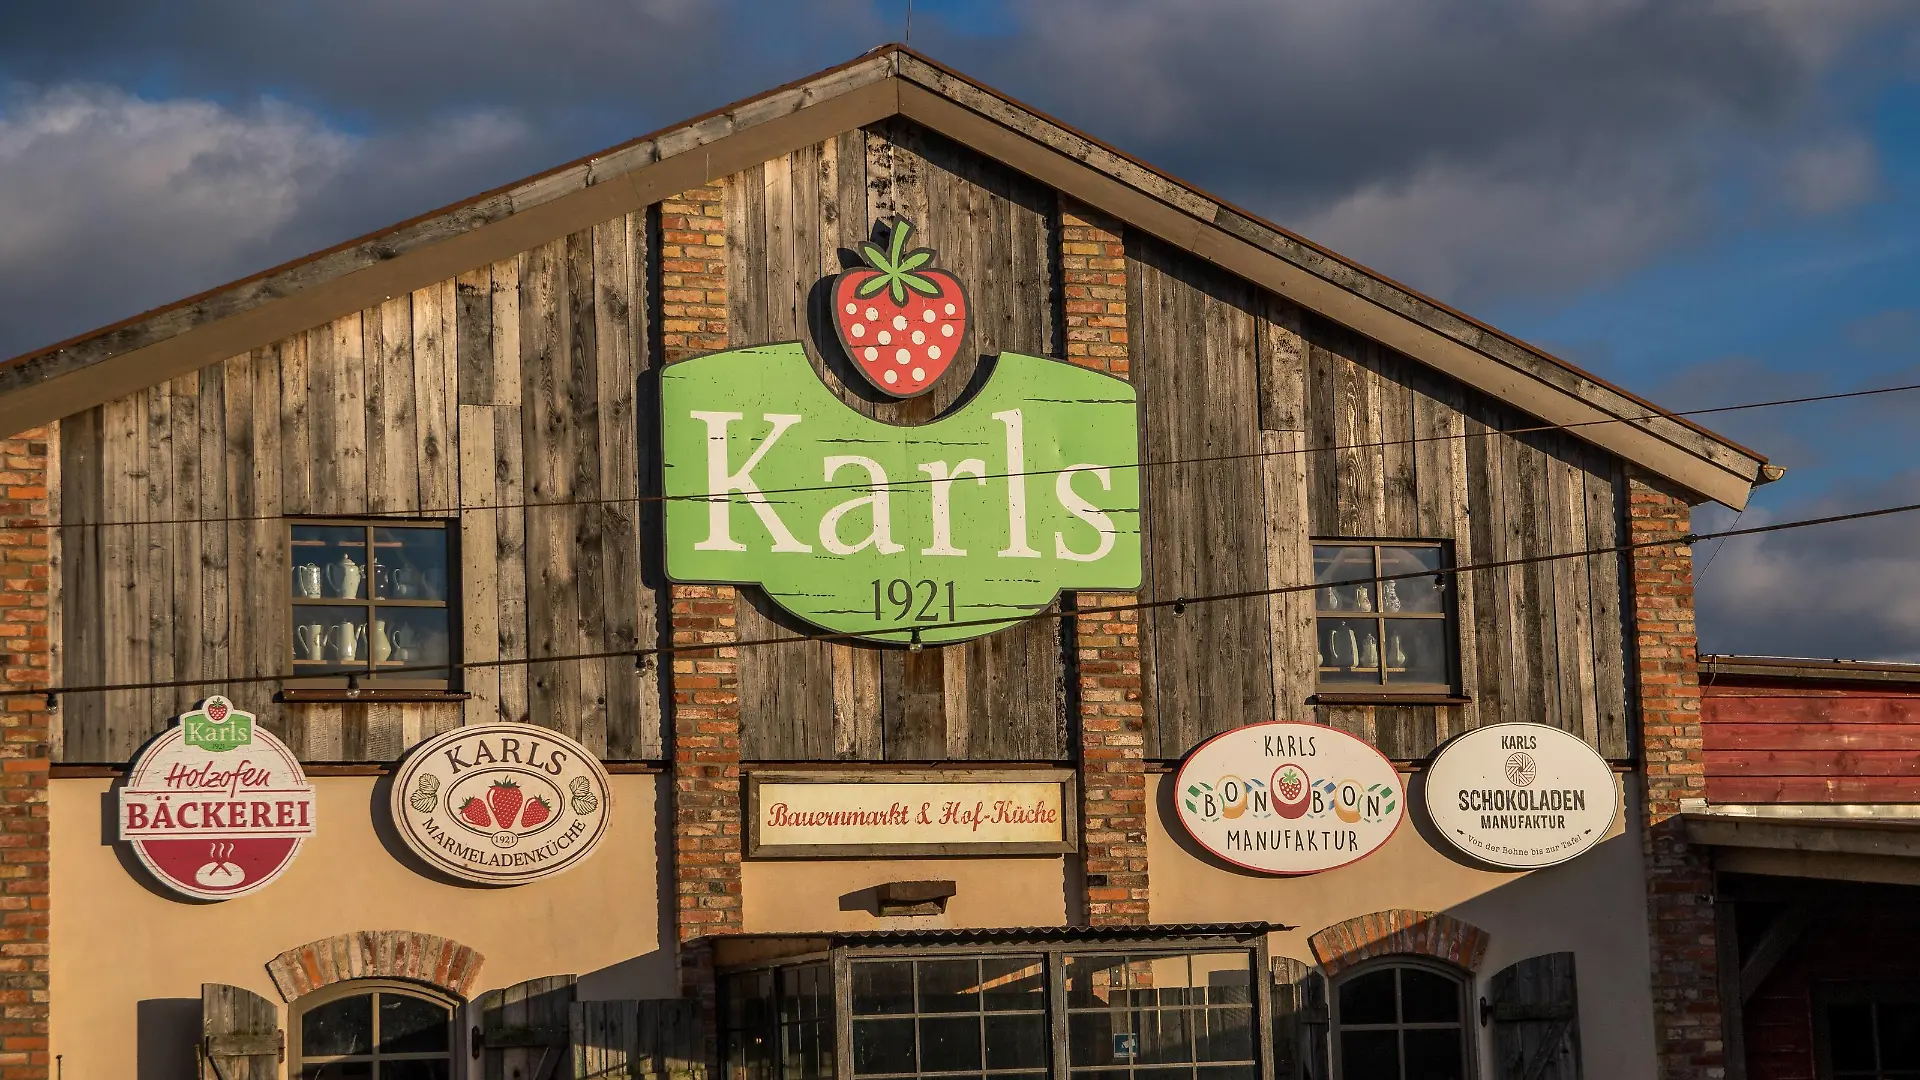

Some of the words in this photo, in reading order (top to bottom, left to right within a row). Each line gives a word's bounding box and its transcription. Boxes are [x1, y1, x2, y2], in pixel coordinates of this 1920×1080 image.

[690, 408, 1116, 562] Karls
[871, 578, 956, 622] 1921
[188, 721, 248, 742] Karls
[1501, 735, 1537, 750] KARLS
[444, 738, 567, 775] KARLS
[1264, 735, 1317, 757] KARLS
[164, 760, 271, 798] Holzofen
[1458, 789, 1585, 811] SCHOKOLADEN
[126, 795, 310, 829] BÄCKEREI
[767, 802, 909, 827] Bauernmarkt
[914, 802, 932, 825] &
[938, 800, 1057, 832] Hof-Küche
[1480, 815, 1565, 829] MANUFAKTUR
[421, 817, 586, 867] MARMELADENKÜCHE
[494, 834, 515, 844] 1921
[1227, 829, 1358, 851] MANUFAKTUR
[1468, 834, 1484, 848] Von
[1485, 841, 1500, 853] der
[1502, 846, 1529, 856] Bohne
[1531, 846, 1544, 856] bis
[1545, 844, 1560, 855] zur
[1560, 835, 1583, 849] Tafel
